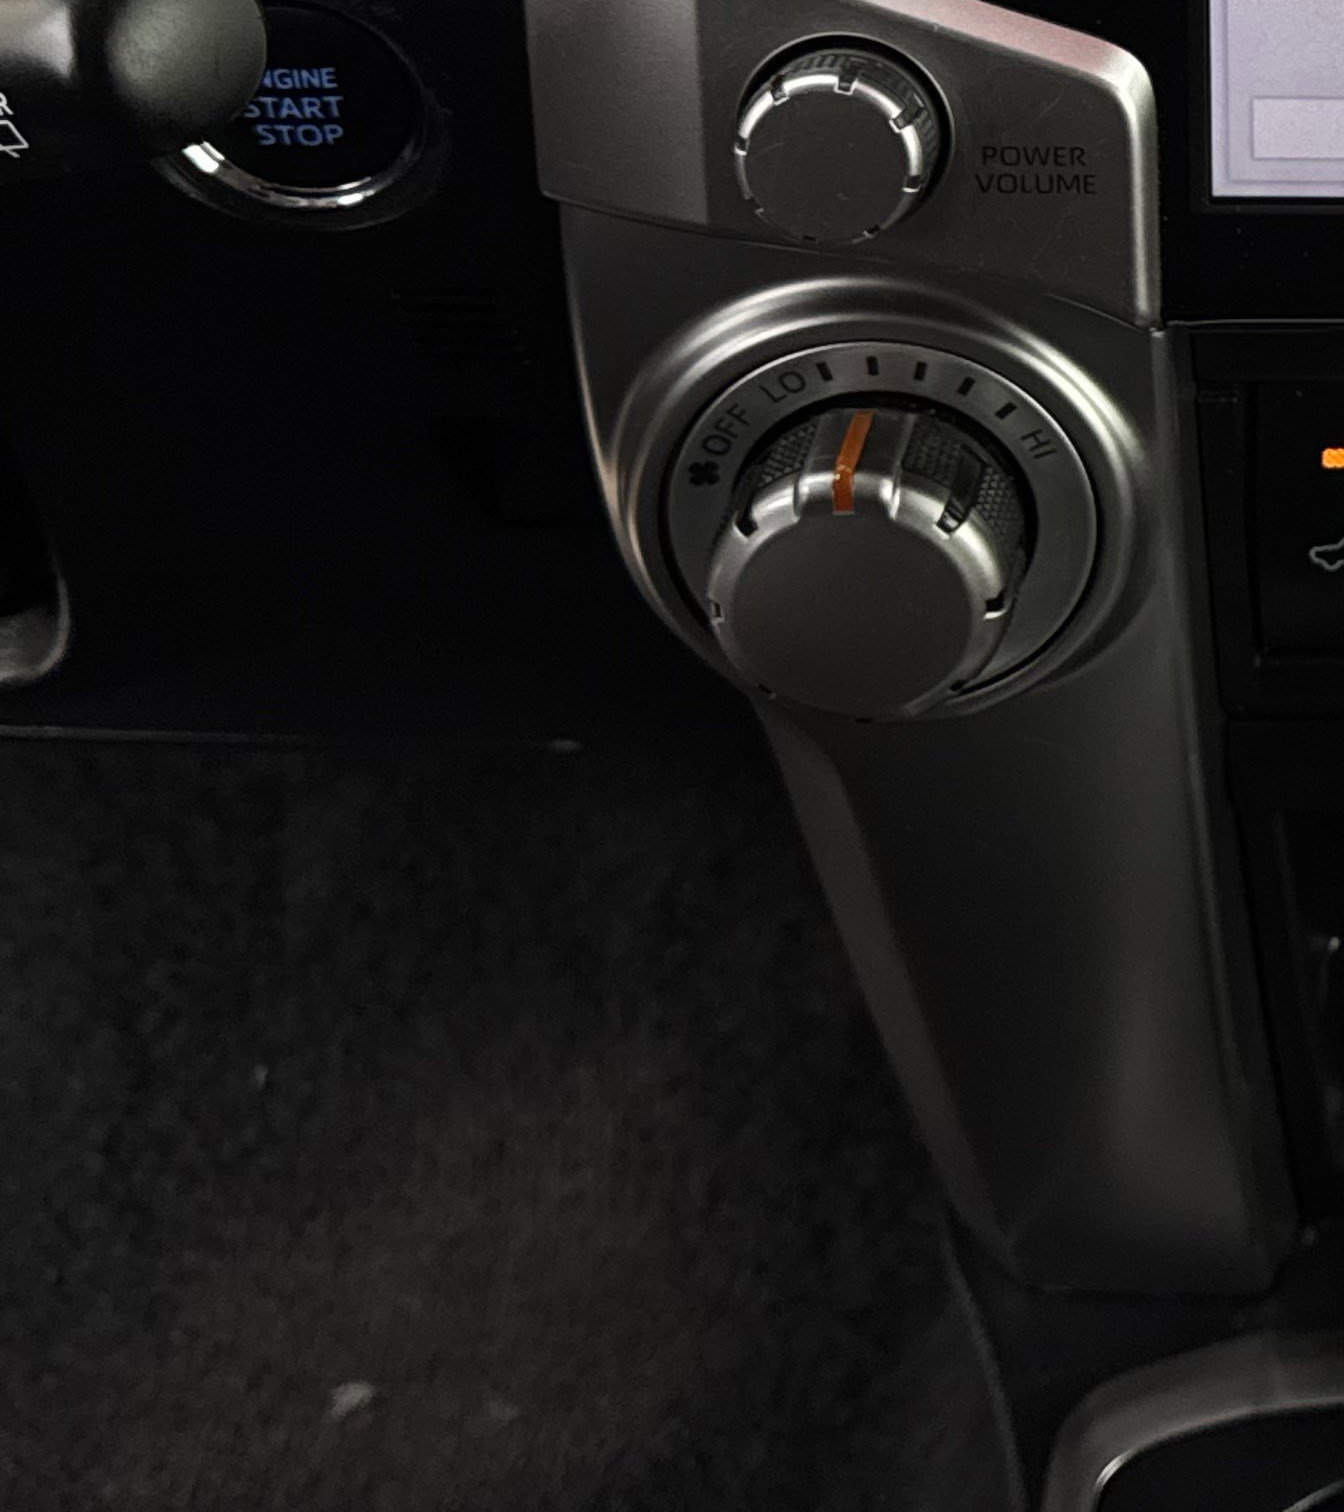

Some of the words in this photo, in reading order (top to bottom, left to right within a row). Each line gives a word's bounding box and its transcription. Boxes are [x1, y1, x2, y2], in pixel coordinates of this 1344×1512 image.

[260, 66, 338, 89] NGINE
[244, 94, 344, 119] START
[253, 123, 344, 147] STOP
[981, 145, 1087, 168] POWER
[974, 173, 1097, 196] VOLUME
[703, 401, 751, 458] OFF
[765, 370, 808, 405] LO
[1021, 428, 1057, 461] HI
